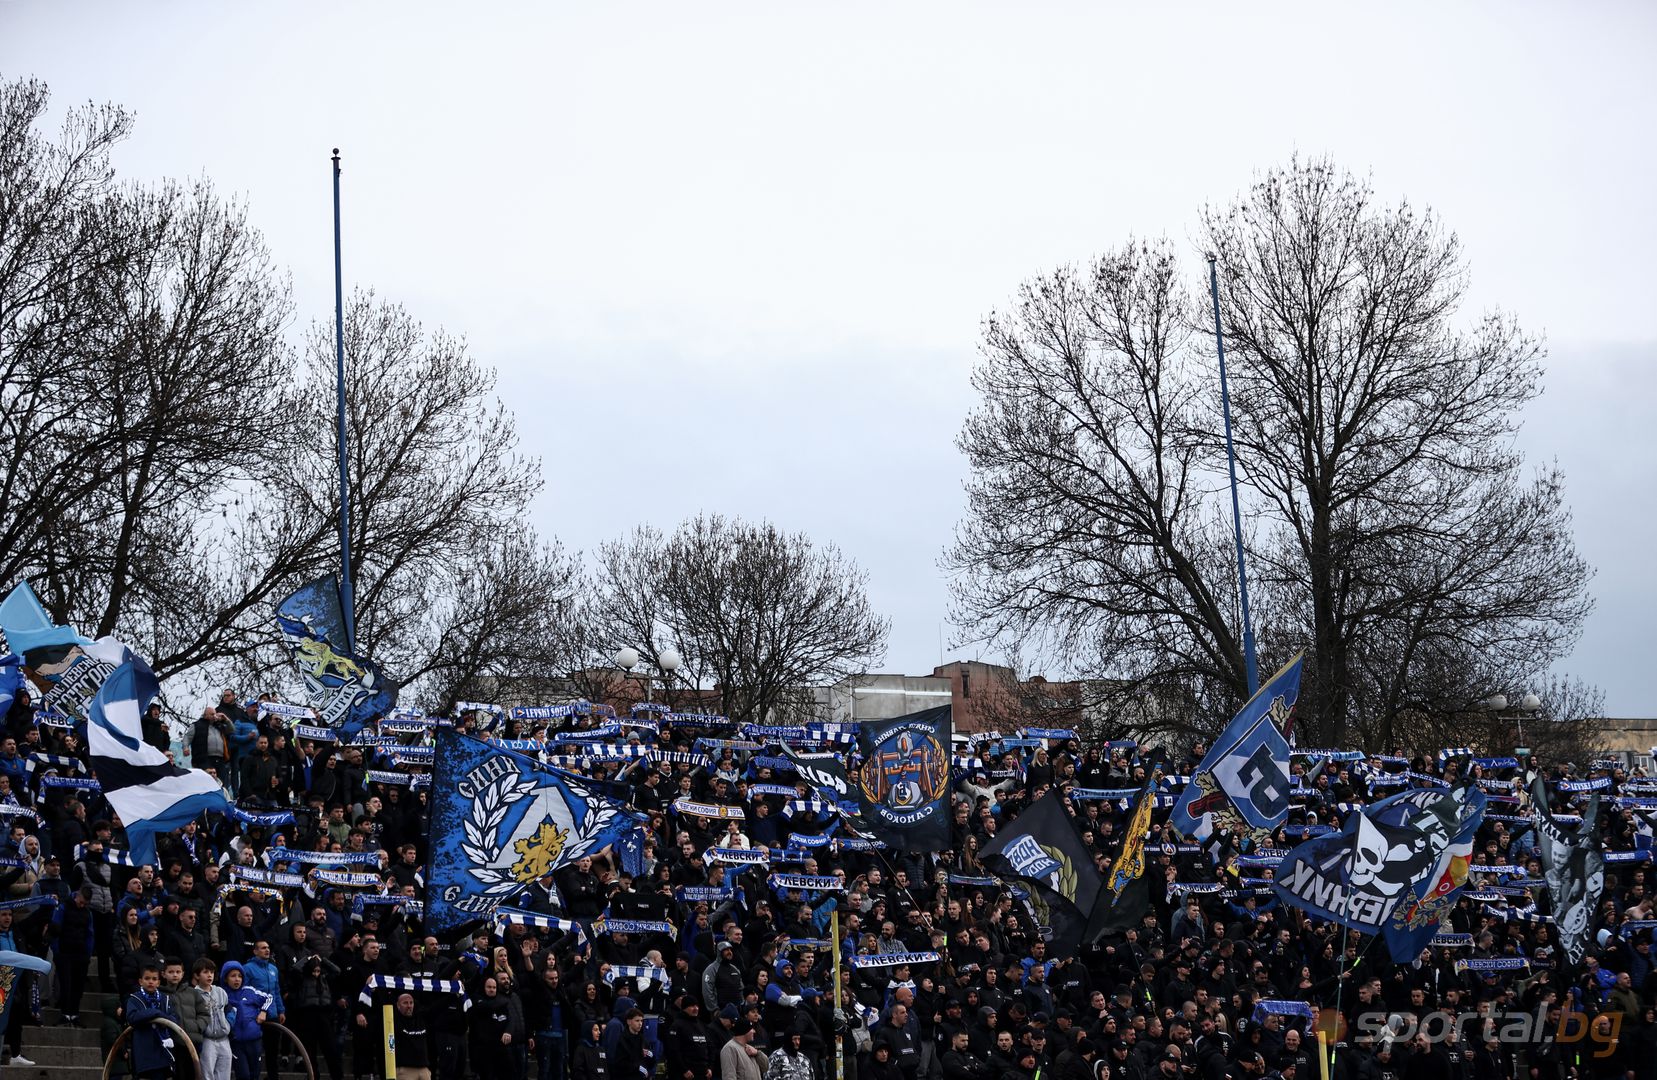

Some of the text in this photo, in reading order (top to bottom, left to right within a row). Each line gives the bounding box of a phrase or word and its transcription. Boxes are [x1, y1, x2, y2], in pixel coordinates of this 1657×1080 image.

[299, 725, 327, 738] ЛЕВСКИ
[388, 720, 423, 732] ЛЕВСКИ
[698, 806, 717, 816] СОФИЯ
[721, 850, 758, 862] ЛЕВСКИ
[784, 876, 831, 887] ЛЕВСКИ
[871, 953, 923, 965] ЛЕВСКИ
[1471, 959, 1521, 969] ЛЕВСКИ СОФИЯ
